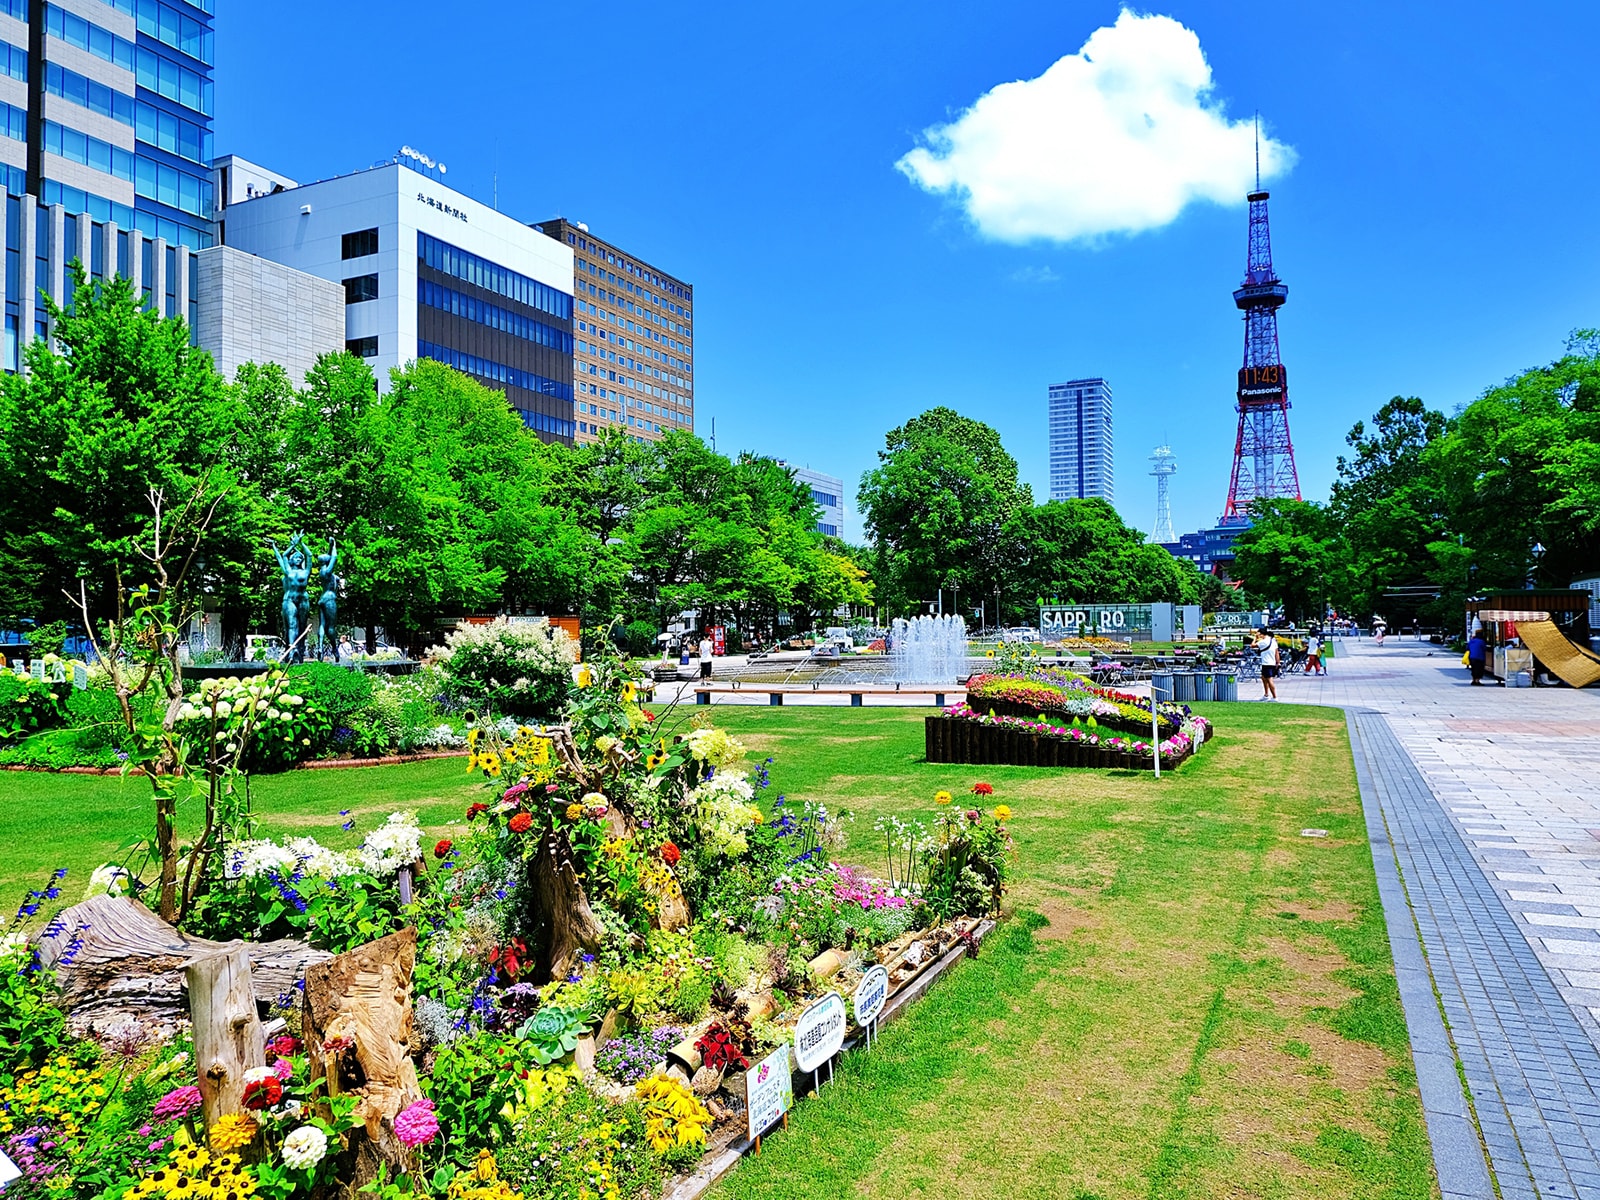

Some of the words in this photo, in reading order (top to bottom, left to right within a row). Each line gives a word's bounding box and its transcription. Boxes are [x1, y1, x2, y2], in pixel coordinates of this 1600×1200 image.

[417, 192, 468, 223] 北海道新聞社
[1244, 366, 1278, 385] 11:43
[1241, 387, 1282, 396] Panasonic
